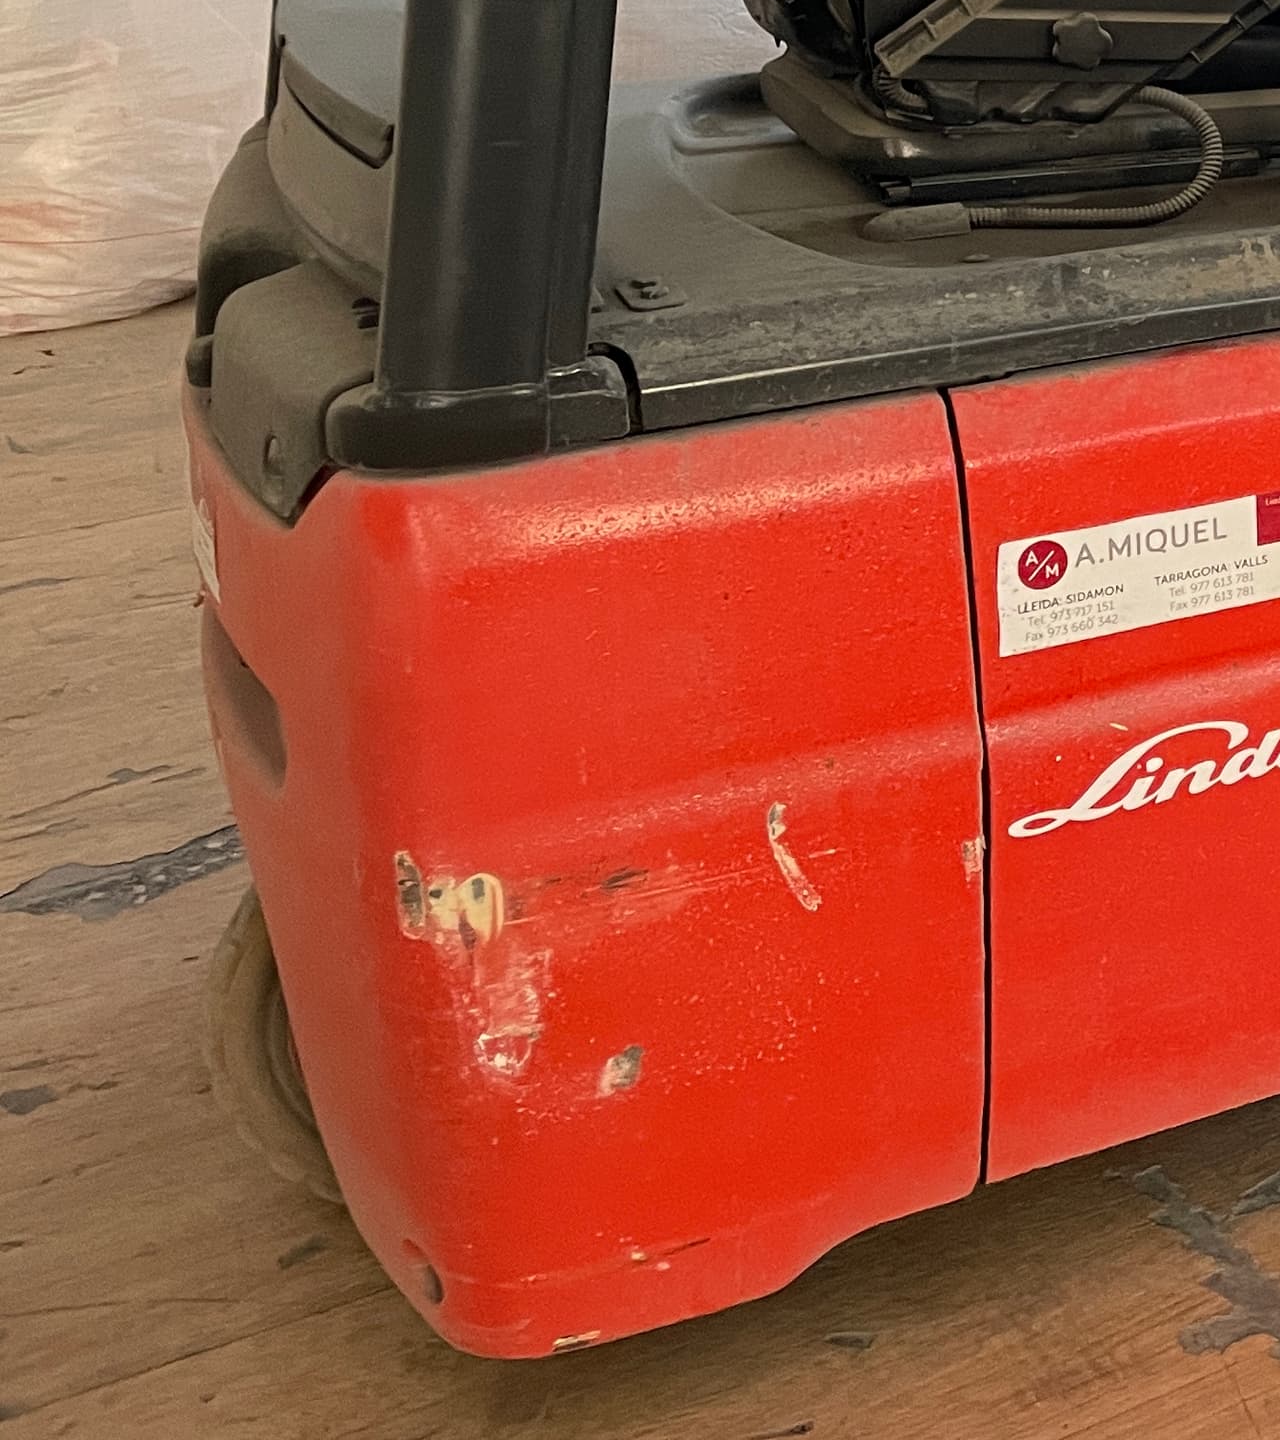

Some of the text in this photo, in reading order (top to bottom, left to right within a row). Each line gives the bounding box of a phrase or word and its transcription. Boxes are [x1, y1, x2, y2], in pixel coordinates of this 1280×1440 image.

[1074, 517, 1228, 568] A.MIQUEL
[1234, 555, 1268, 569] VALLS
[1190, 580, 1210, 593] 977
[1213, 576, 1233, 588] 613
[1236, 572, 1254, 584] 781
[1066, 584, 1124, 604] SIDAMON
[1170, 586, 1254, 612] Fax 977 613 781
[1050, 607, 1071, 621] 973
[1097, 600, 1115, 613] 151
[1025, 614, 1120, 642] Fax 973 660 342
